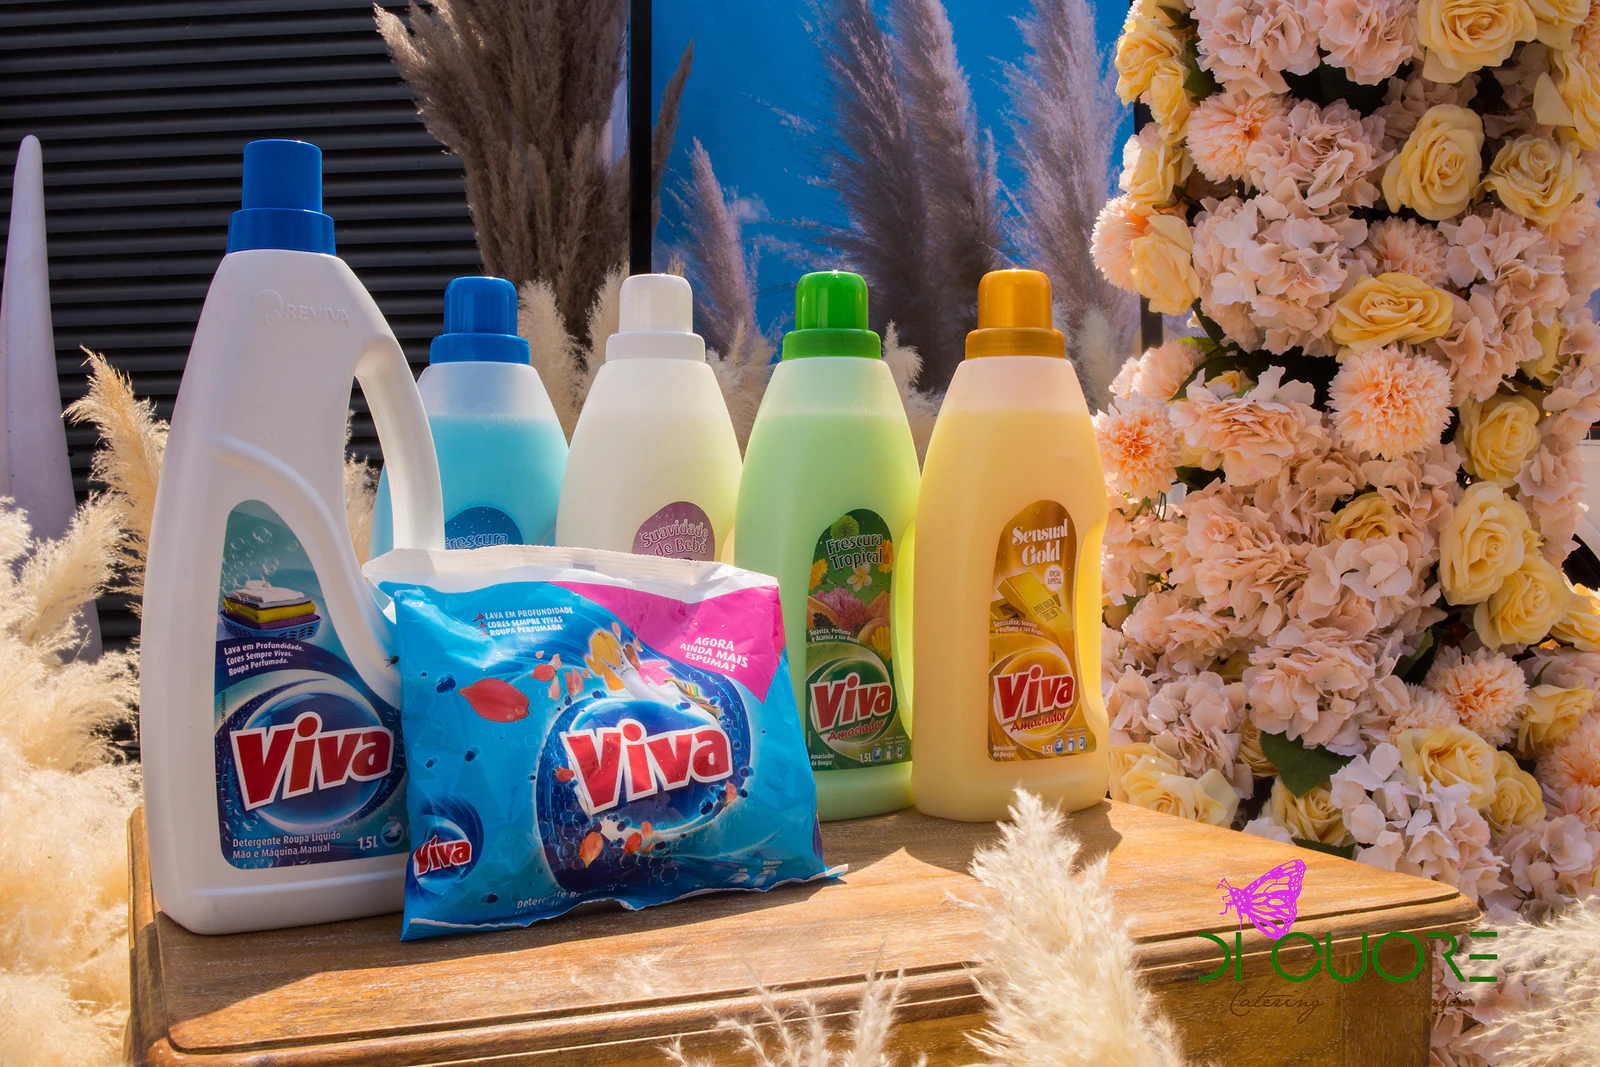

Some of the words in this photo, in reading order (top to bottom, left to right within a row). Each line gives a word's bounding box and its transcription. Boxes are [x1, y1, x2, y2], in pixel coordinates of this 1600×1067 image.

[285, 303, 351, 327] REVIVA
[641, 519, 709, 548] Suavidade
[1011, 518, 1068, 546] Sensual
[655, 542, 674, 558] de
[825, 533, 884, 555] Frescura
[1021, 540, 1061, 567] Gold
[829, 547, 884, 570] Tropical
[485, 612, 504, 620] LAVA
[505, 611, 516, 619] EM
[517, 606, 574, 618] PROFUNDIDADE
[487, 620, 511, 629] CORES
[511, 618, 541, 627] SEMPRE
[541, 615, 563, 625] VIVAS
[489, 627, 517, 637] ROUPA
[517, 623, 563, 634] PERFUMADA
[809, 627, 831, 636] Suaviza,
[223, 645, 241, 656] Lava
[242, 643, 255, 651] em
[255, 641, 305, 652] Profundidade.
[693, 636, 735, 652] AGORA
[226, 654, 245, 666] Cores
[245, 650, 273, 661] Sempre
[273, 649, 294, 657] Vivas.
[679, 642, 713, 657] AINDA
[715, 649, 749, 668] MAIS
[684, 651, 737, 673] ESPUMA!
[228, 663, 250, 677] Roupa
[250, 657, 289, 669] Perfumada.
[809, 672, 893, 733] Viva
[993, 664, 1075, 725] Viva
[827, 719, 885, 742] Amaciador
[1010, 711, 1066, 732] Amaciador
[859, 753, 872, 764] 1,5L
[1041, 744, 1054, 756] 1,5L
[229, 711, 395, 812] Viva
[559, 718, 734, 815] Viva
[232, 837, 281, 848] Detergente
[283, 834, 309, 844] Roupa
[232, 849, 251, 859] Mão
[261, 847, 298, 857] Máquina
[299, 843, 330, 854] Manual
[357, 835, 379, 851] 1,5L
[413, 834, 472, 877] Viva
